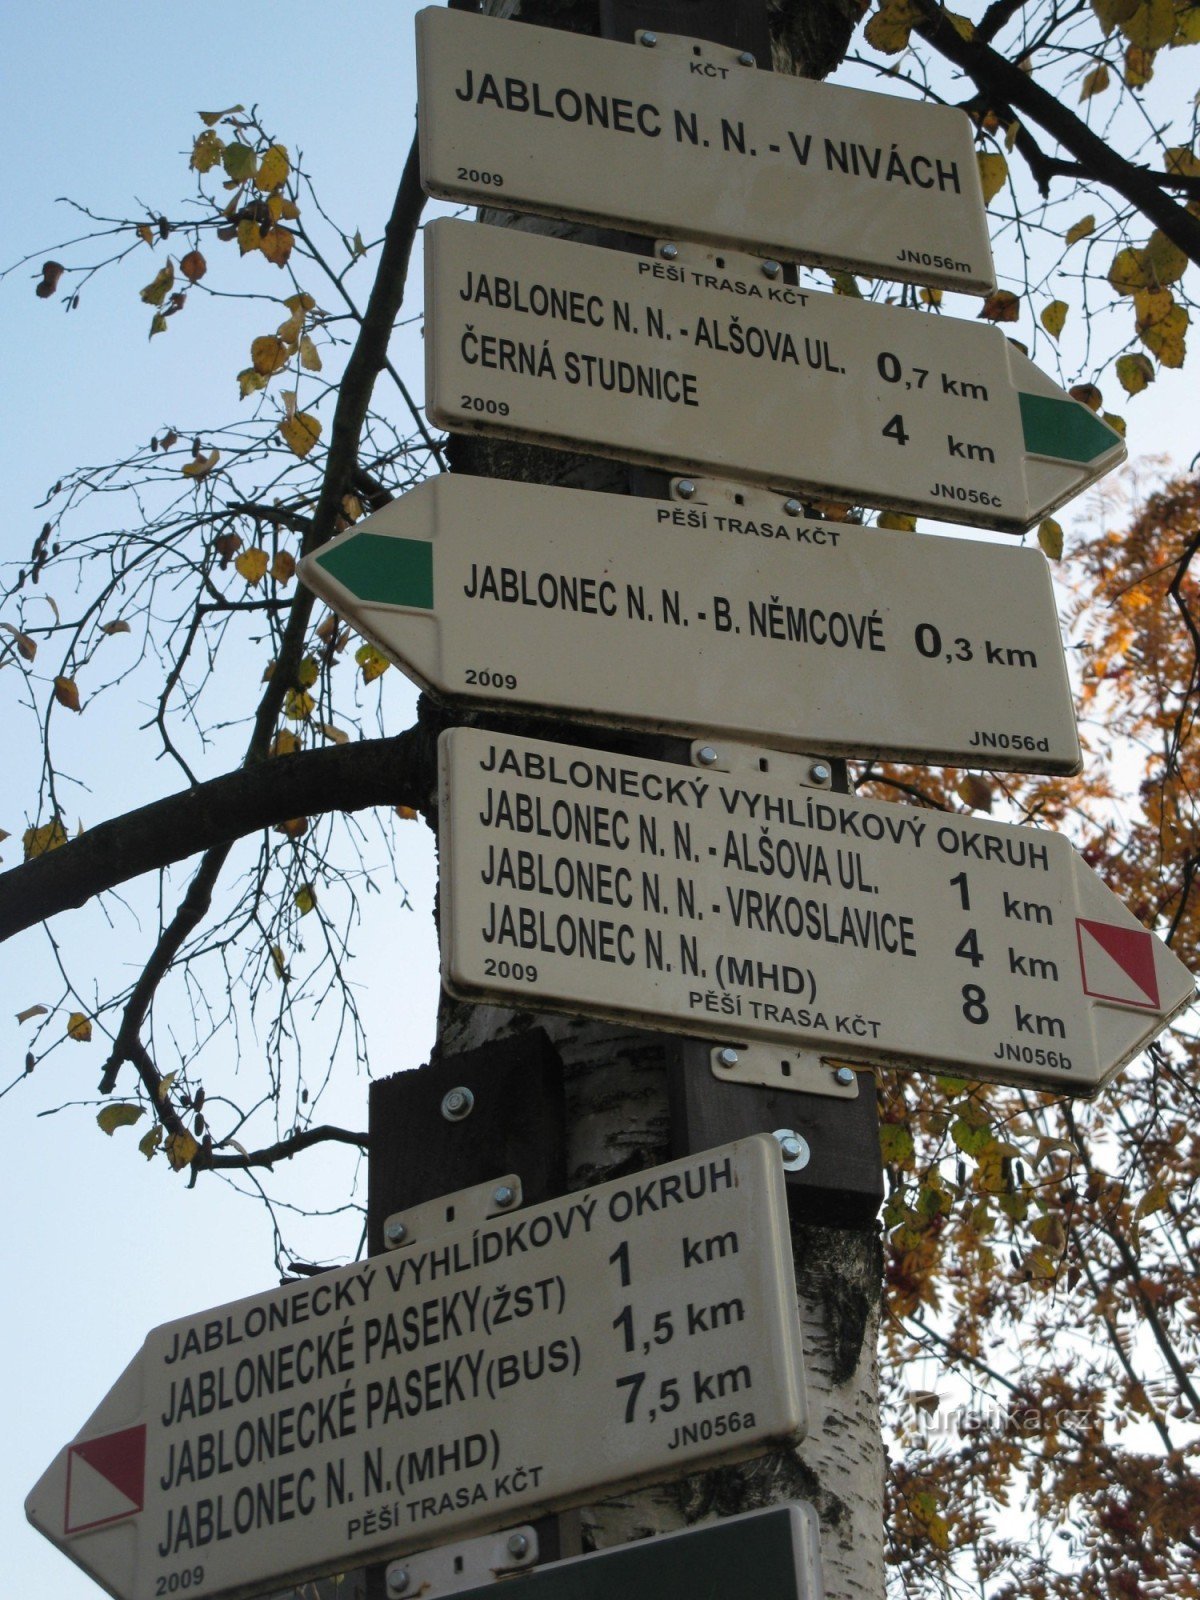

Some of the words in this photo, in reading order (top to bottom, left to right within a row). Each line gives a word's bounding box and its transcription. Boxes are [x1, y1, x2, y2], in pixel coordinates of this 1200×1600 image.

[689, 61, 730, 80] KČT
[455, 69, 662, 138] JABLONEC
[673, 109, 710, 148] N.
[720, 117, 757, 157] N.
[787, 131, 813, 166] V
[823, 138, 961, 194] NIVÁCH
[457, 167, 504, 187] 2009
[638, 261, 685, 283] PĚŠÍ
[690, 272, 763, 299] TRASA
[767, 287, 809, 307] KČT
[896, 249, 972, 273] JN056m
[459, 271, 605, 328] JABLONEC
[613, 302, 638, 335] N.
[646, 309, 672, 341] N.
[694, 315, 800, 366] ALŠOVA
[804, 337, 846, 375] UL.
[461, 323, 557, 381] ČERNÁ
[564, 351, 699, 407] STUDNICE
[877, 351, 929, 391] 0,7
[941, 373, 989, 402] km
[460, 395, 510, 417] 2009
[881, 413, 910, 446] 4
[947, 434, 995, 464] km
[930, 483, 1002, 508] JN056c
[657, 503, 709, 529] PĚŠÍ
[713, 516, 791, 541] TRASA
[796, 526, 841, 547] KČT
[463, 563, 618, 617] JABLONEC
[626, 584, 653, 622] N.
[661, 588, 689, 627] N.
[713, 596, 740, 634] B.
[748, 596, 886, 652] NĚMCOVÉ
[914, 623, 974, 664] 0,3
[985, 640, 1038, 668] km
[465, 669, 517, 690] 2009
[969, 731, 1050, 753] JN056d
[479, 745, 710, 809] JABLONECKÝ
[718, 786, 927, 848] VYHLÍDKOVÝ
[936, 826, 1049, 871] OKRUH
[479, 787, 630, 851] JABLONEC
[639, 815, 665, 857] N.
[673, 820, 700, 863] N.
[723, 826, 832, 886] ALŠOVA
[837, 850, 879, 895] UL.
[481, 845, 633, 909] JABLONEC
[642, 871, 668, 915] N.
[677, 878, 703, 921] N.
[726, 885, 917, 957] VRKOSLAVICE
[949, 871, 971, 911] 1
[1002, 891, 1053, 926] km
[481, 903, 636, 966] JABLONEC
[644, 928, 672, 973] N.
[680, 934, 707, 978] N.
[715, 954, 817, 1005] (MHD)
[484, 958, 538, 983] 2009
[954, 928, 984, 968] 4
[1008, 947, 1059, 982] km
[689, 989, 742, 1016] PĚŠÍ
[748, 1000, 830, 1031] TRASA
[835, 1014, 881, 1039] KČT
[961, 983, 989, 1025] 8
[1014, 1004, 1066, 1039] km
[993, 1042, 1072, 1070] JN056b
[164, 1264, 377, 1365] JABLONECKÝ
[385, 1195, 598, 1292] VYHLÍDKOVÝ
[608, 1157, 732, 1223] OKRUH
[609, 1240, 631, 1288] 1
[682, 1231, 739, 1268] km
[612, 1304, 674, 1353] 1,5
[686, 1298, 746, 1336] km
[161, 1315, 355, 1428] JABLONECKÉ
[615, 1371, 681, 1424] 7,5
[693, 1364, 752, 1404] km
[160, 1378, 357, 1491] JABLONECKÉ
[667, 1411, 756, 1450] JN056a
[158, 1467, 316, 1558] JABLONEC
[326, 1458, 354, 1504] N.
[347, 1502, 399, 1541] PĚŠÍ
[406, 1483, 489, 1522] TRASA
[494, 1466, 543, 1498] KČT
[155, 1565, 205, 1597] 2009
